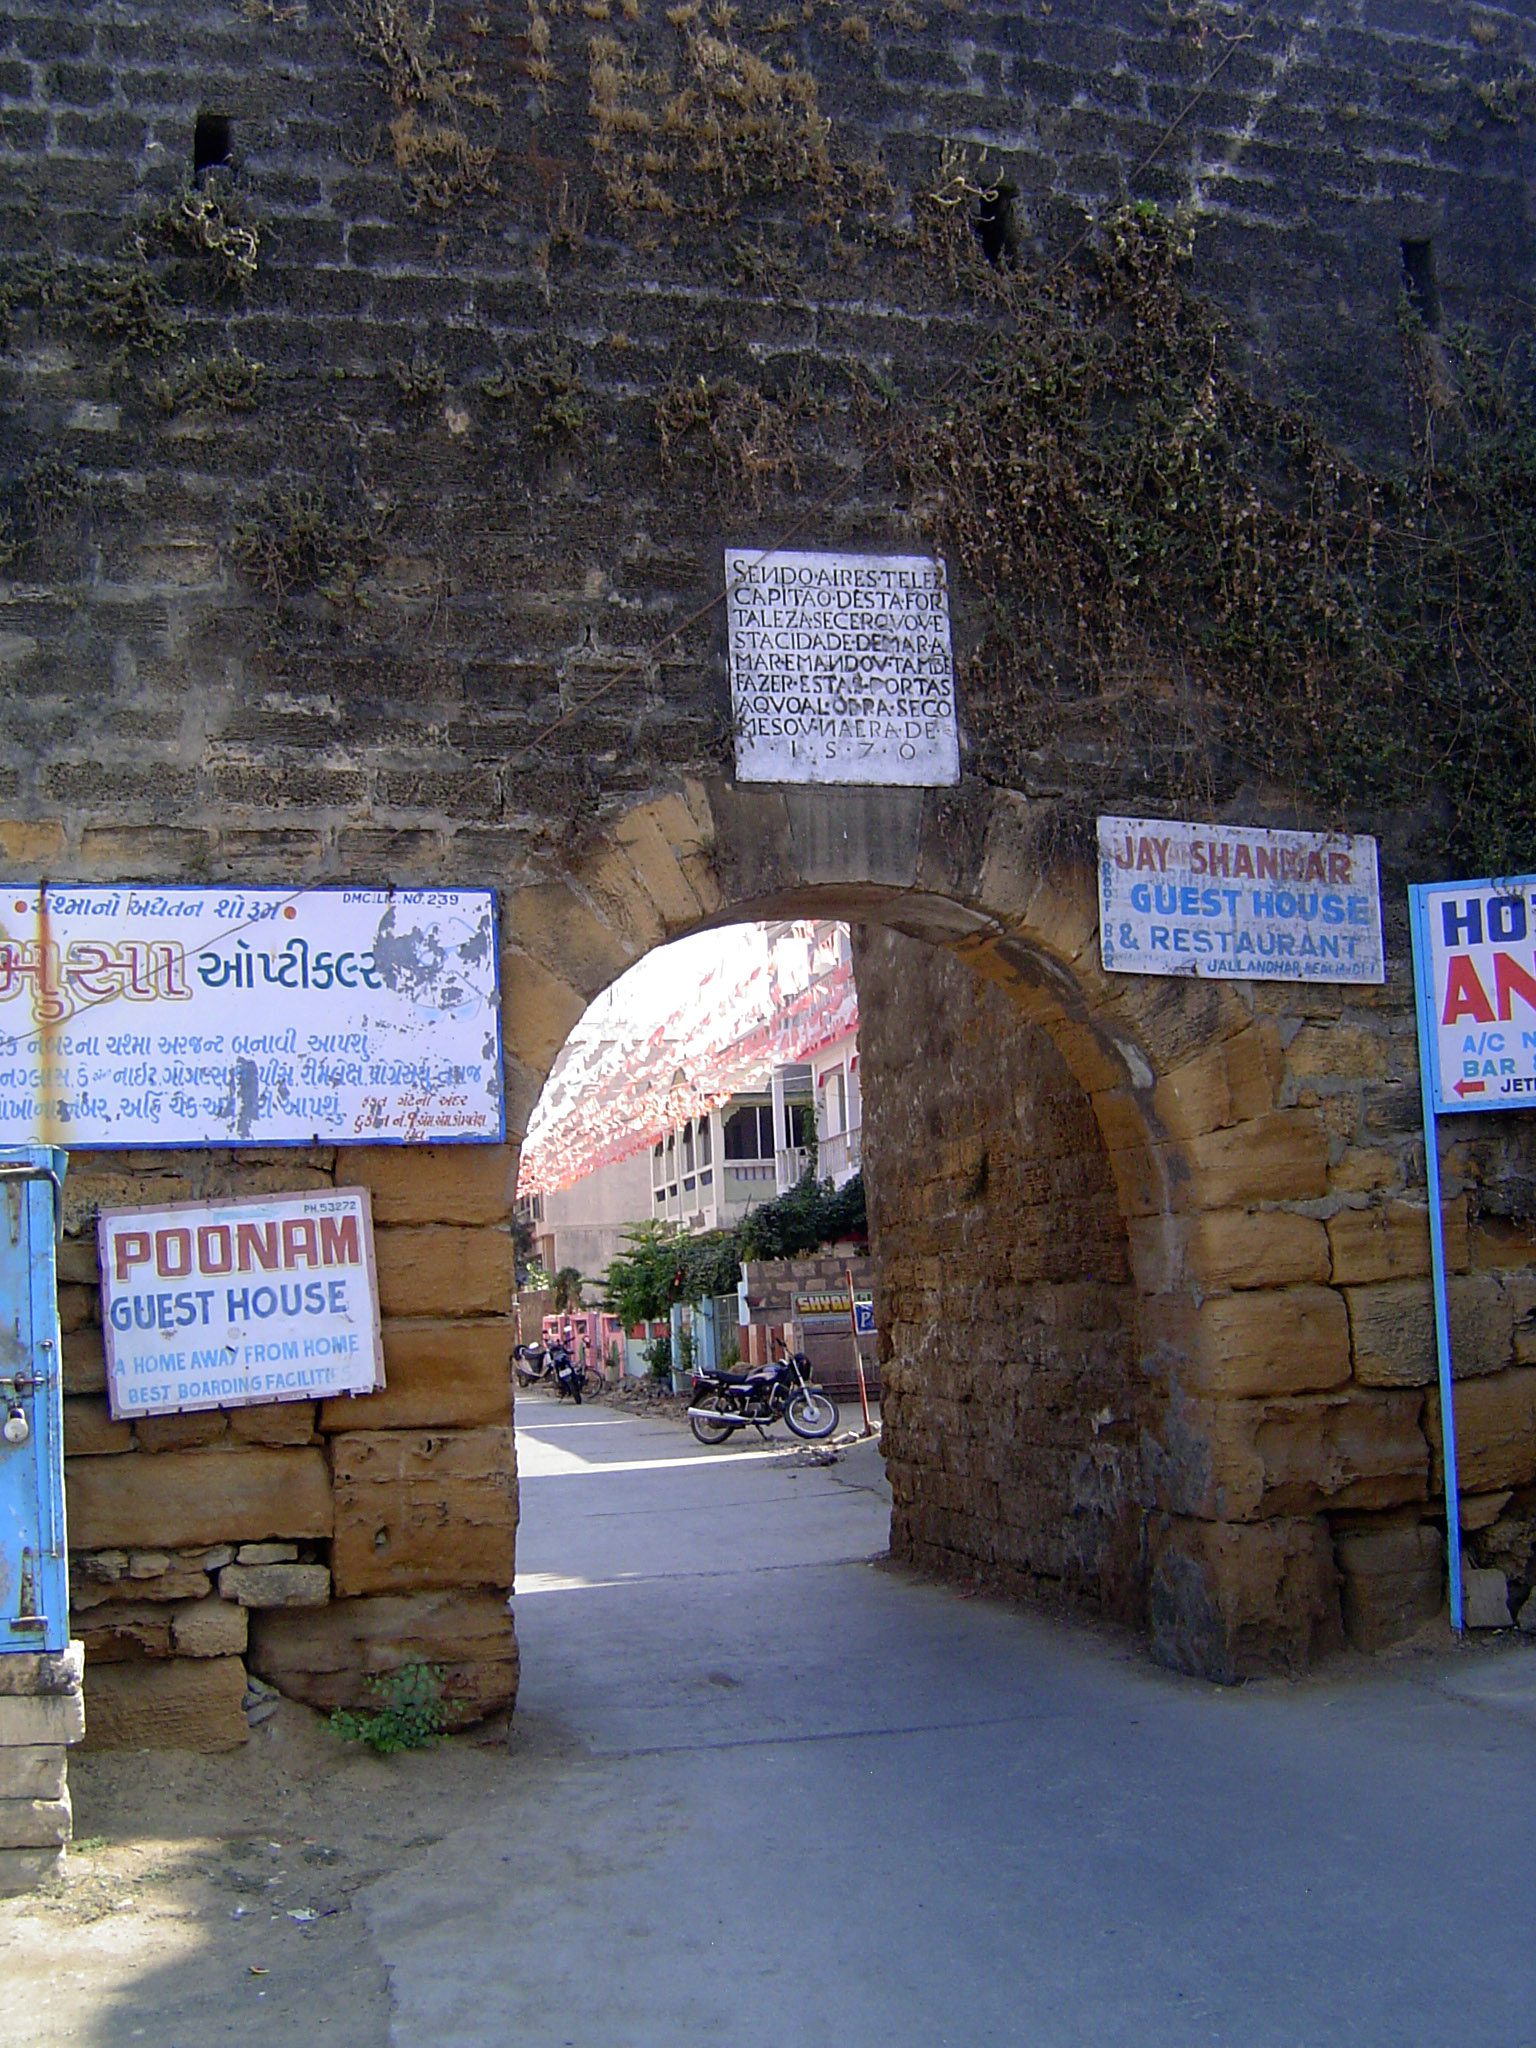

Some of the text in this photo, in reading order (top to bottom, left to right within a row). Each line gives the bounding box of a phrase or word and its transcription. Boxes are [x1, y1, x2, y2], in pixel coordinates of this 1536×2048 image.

[1114, 836, 1171, 873] JAY
[1131, 883, 1369, 925] GUEST HOUSE
[1442, 894, 1536, 947] HO
[1119, 923, 1360, 959] & RESTAURANT
[1463, 1031, 1505, 1056] A/C
[1463, 1058, 1515, 1078] BAR
[1501, 1077, 1536, 1093] JET
[113, 1214, 362, 1284] POONAM
[110, 1279, 347, 1332] GUEST HOUSE
[114, 1333, 360, 1377] A HOME AWAY FROM HOME
[128, 1384, 171, 1405] BEST
[178, 1373, 262, 1399] BOARDING
